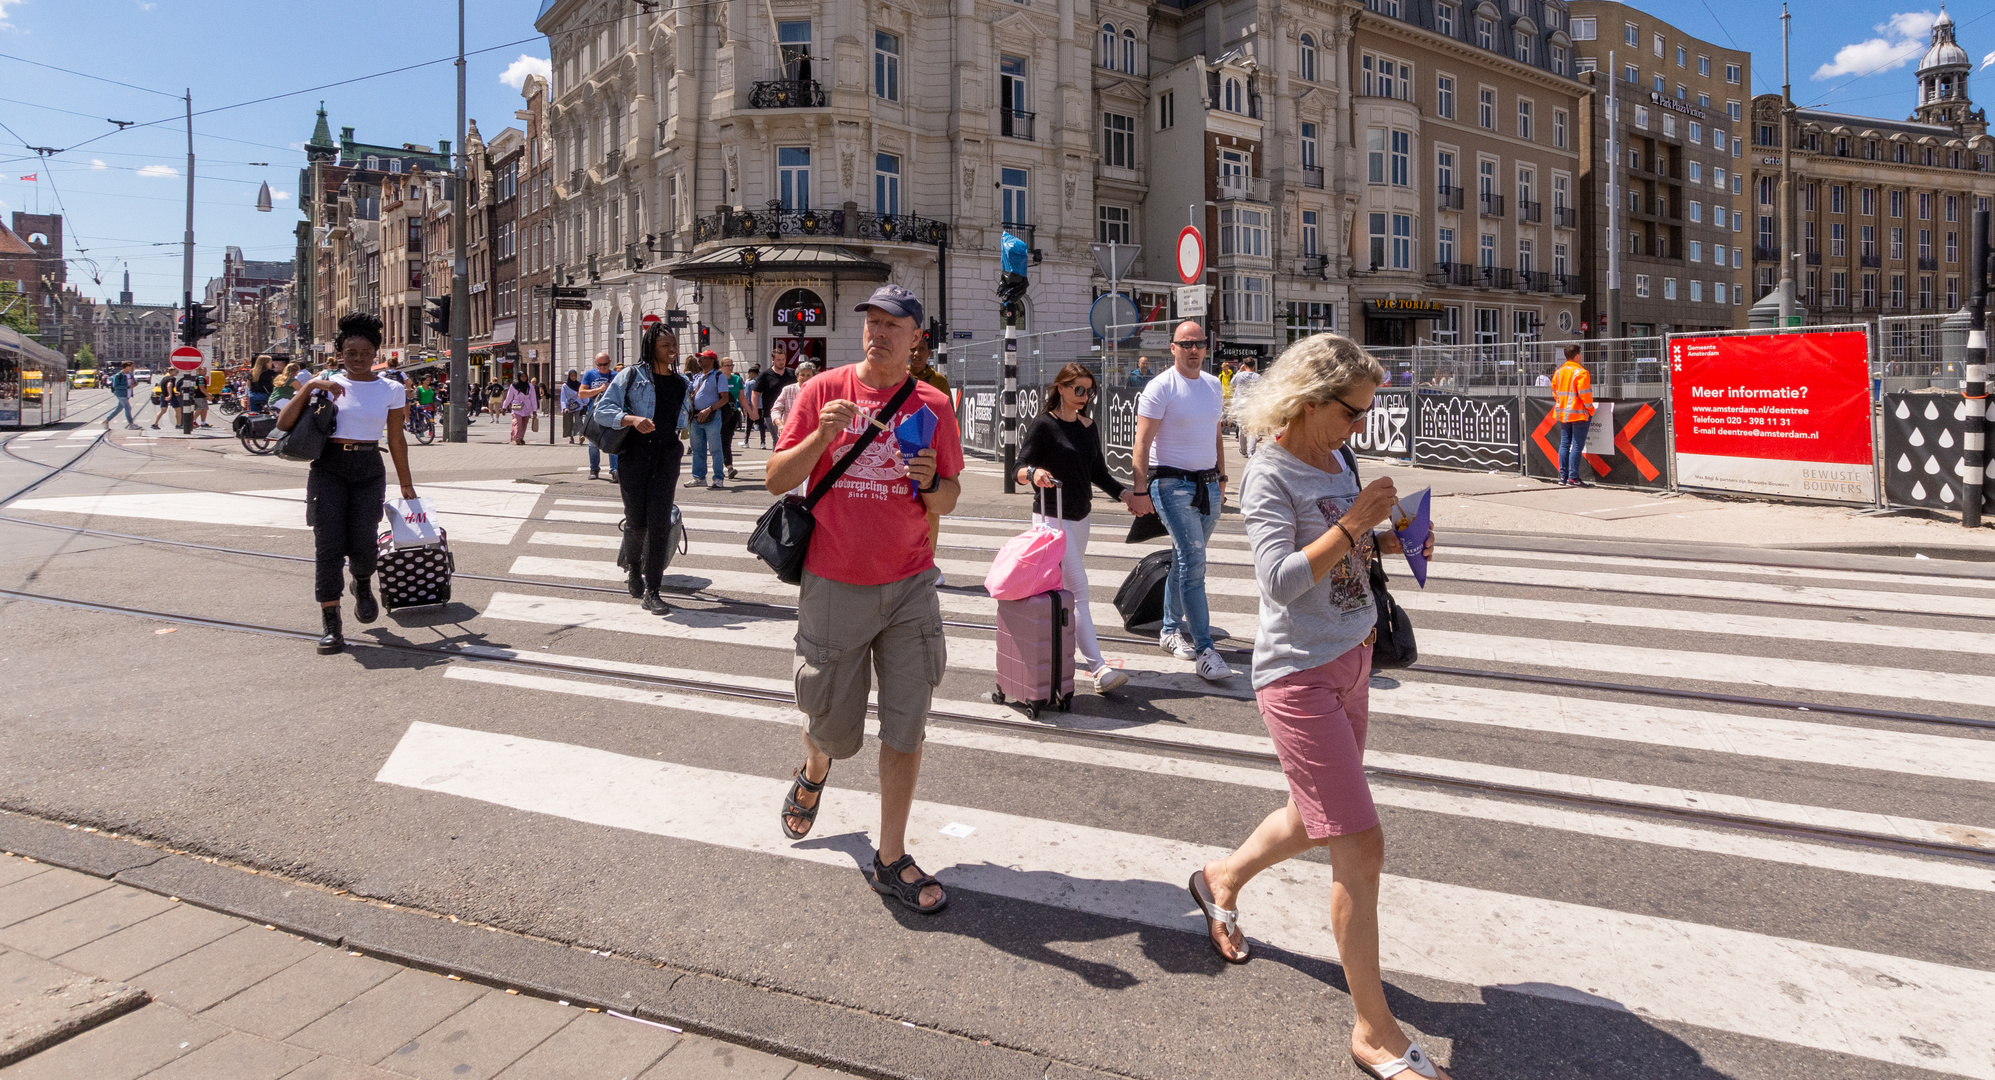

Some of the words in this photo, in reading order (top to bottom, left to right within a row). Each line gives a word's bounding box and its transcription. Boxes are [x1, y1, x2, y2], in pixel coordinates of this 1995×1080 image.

[1660, 96, 1672, 109] Park
[1672, 99, 1686, 114] Plaza
[1686, 103, 1706, 120] Victoria
[702, 278, 767, 288] VICTORIA
[774, 278, 826, 288] HOTEL
[1375, 299, 1429, 310] VICTORIA
[1692, 386, 1724, 398] Meer
[1728, 386, 1808, 399] informatie?
[1692, 405, 1809, 415] www.amsterdam.nl/deentree
[1693, 415, 1725, 424] Telefoon
[1726, 416, 1741, 424] 020
[1749, 417, 1765, 425] 398
[1780, 418, 1790, 426] 31
[1693, 427, 1716, 435] E-mail
[1717, 428, 1819, 439] deentree@amsterdam.nl
[1802, 468, 1861, 482] BEWUSTE
[891, 484, 909, 495] club
[1803, 481, 1862, 494] BOUWERS
[871, 492, 888, 501] 1962
[404, 511, 427, 524] H&M
